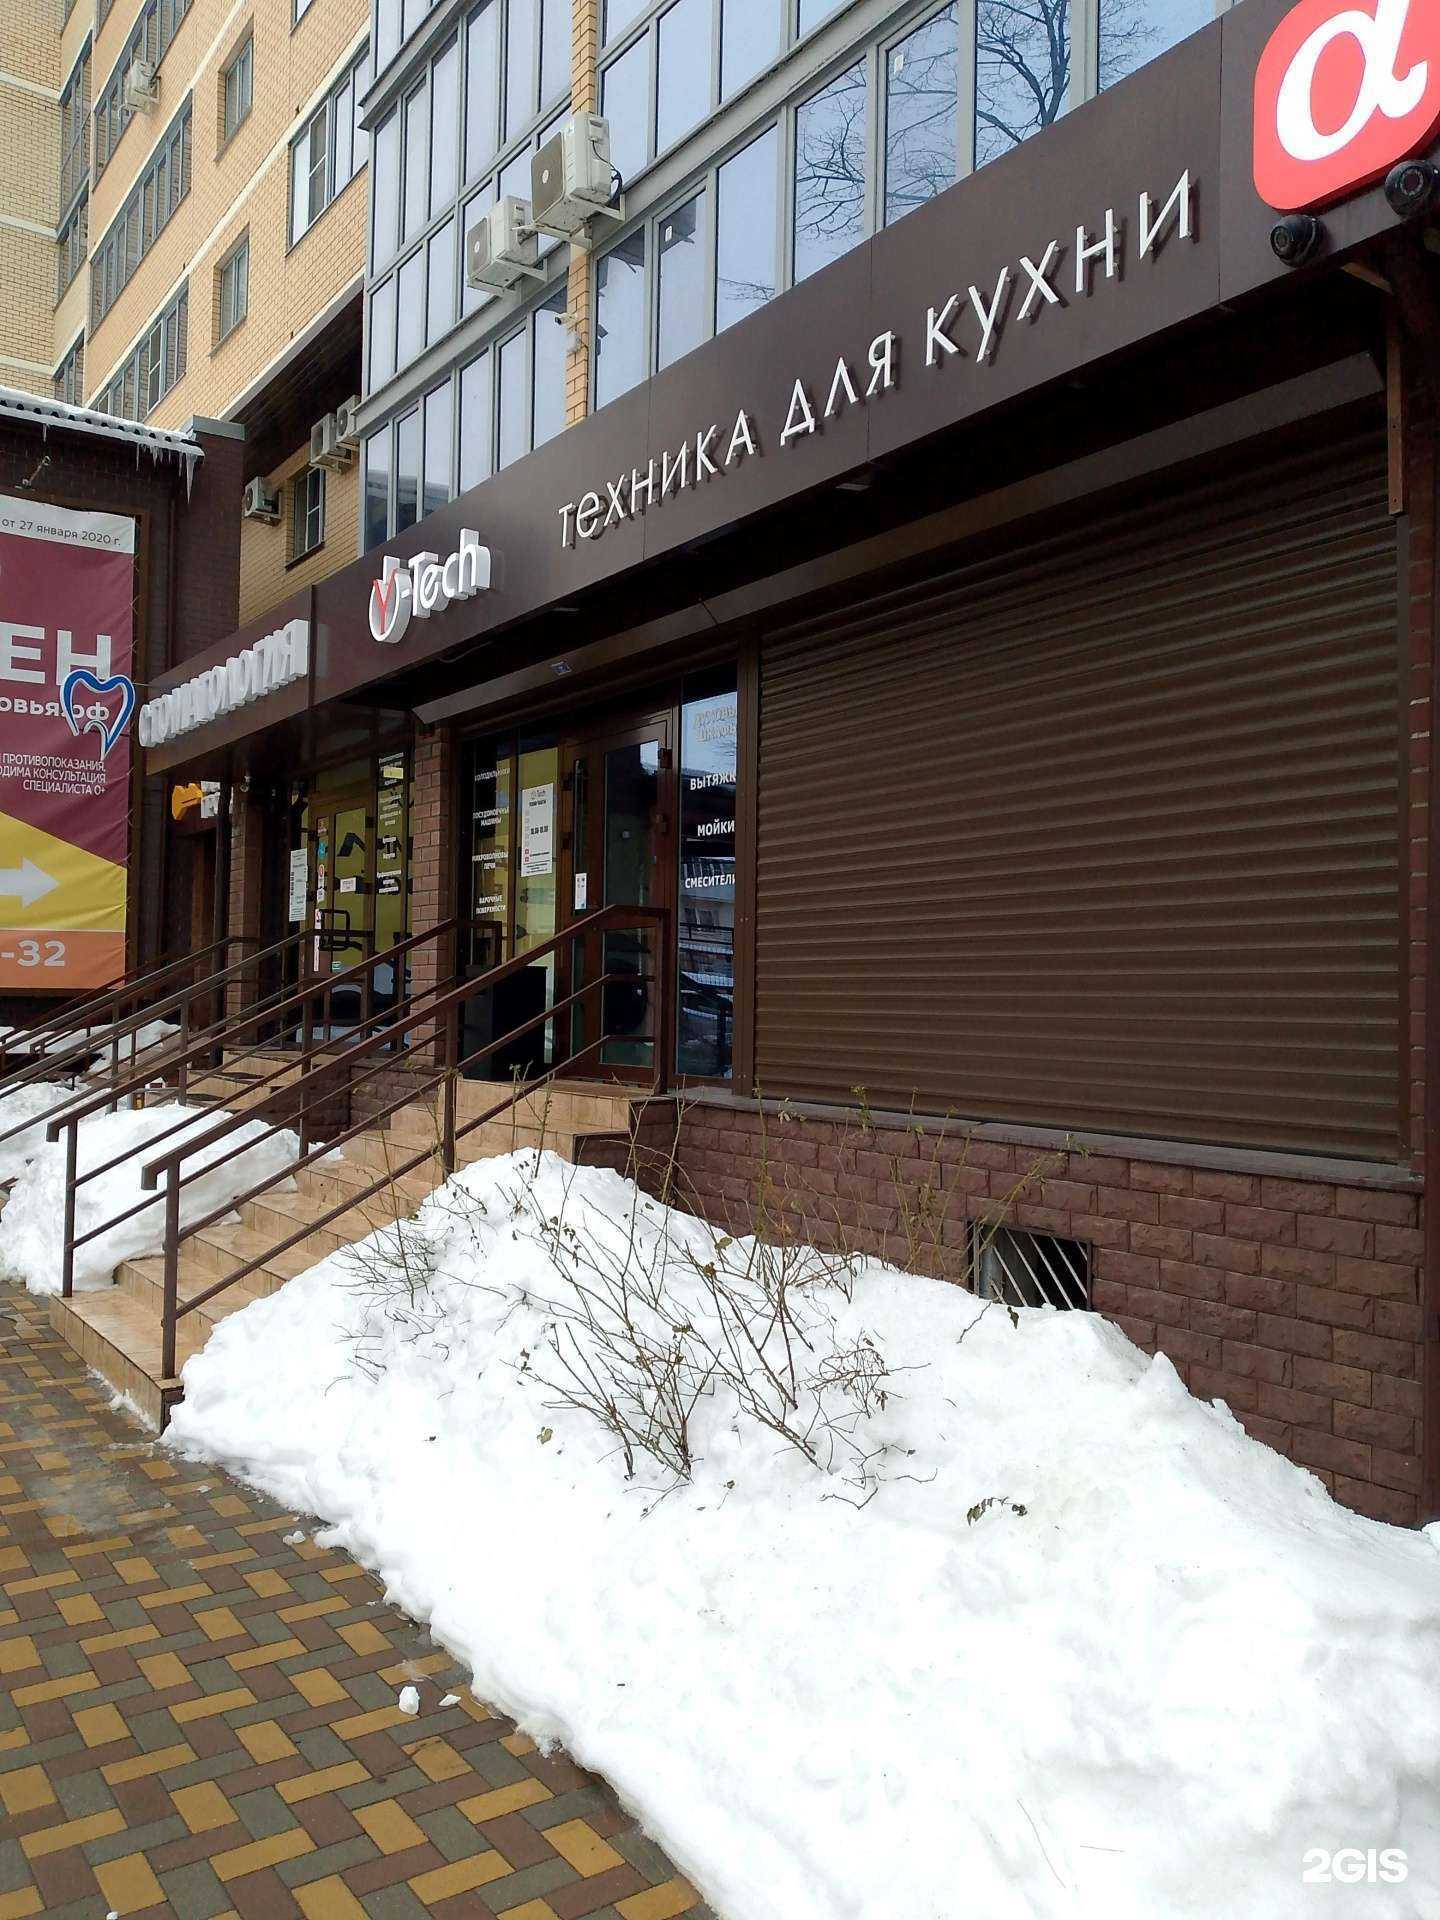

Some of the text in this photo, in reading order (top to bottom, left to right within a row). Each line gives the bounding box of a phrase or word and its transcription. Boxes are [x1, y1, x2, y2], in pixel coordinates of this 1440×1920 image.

[779, 330, 897, 446] ДЛЯ
[925, 168, 1193, 366] КУХНИ
[2, 518, 16, 529] от
[19, 520, 33, 531] 27
[36, 525, 78, 540] января
[81, 531, 111, 544] 2020
[33, 768, 106, 785] КОНСУЛЬТАЦИЯ
[22, 779, 92, 795] СПЕЦИАЛИСТА
[697, 818, 735, 837] МОЙКИ
